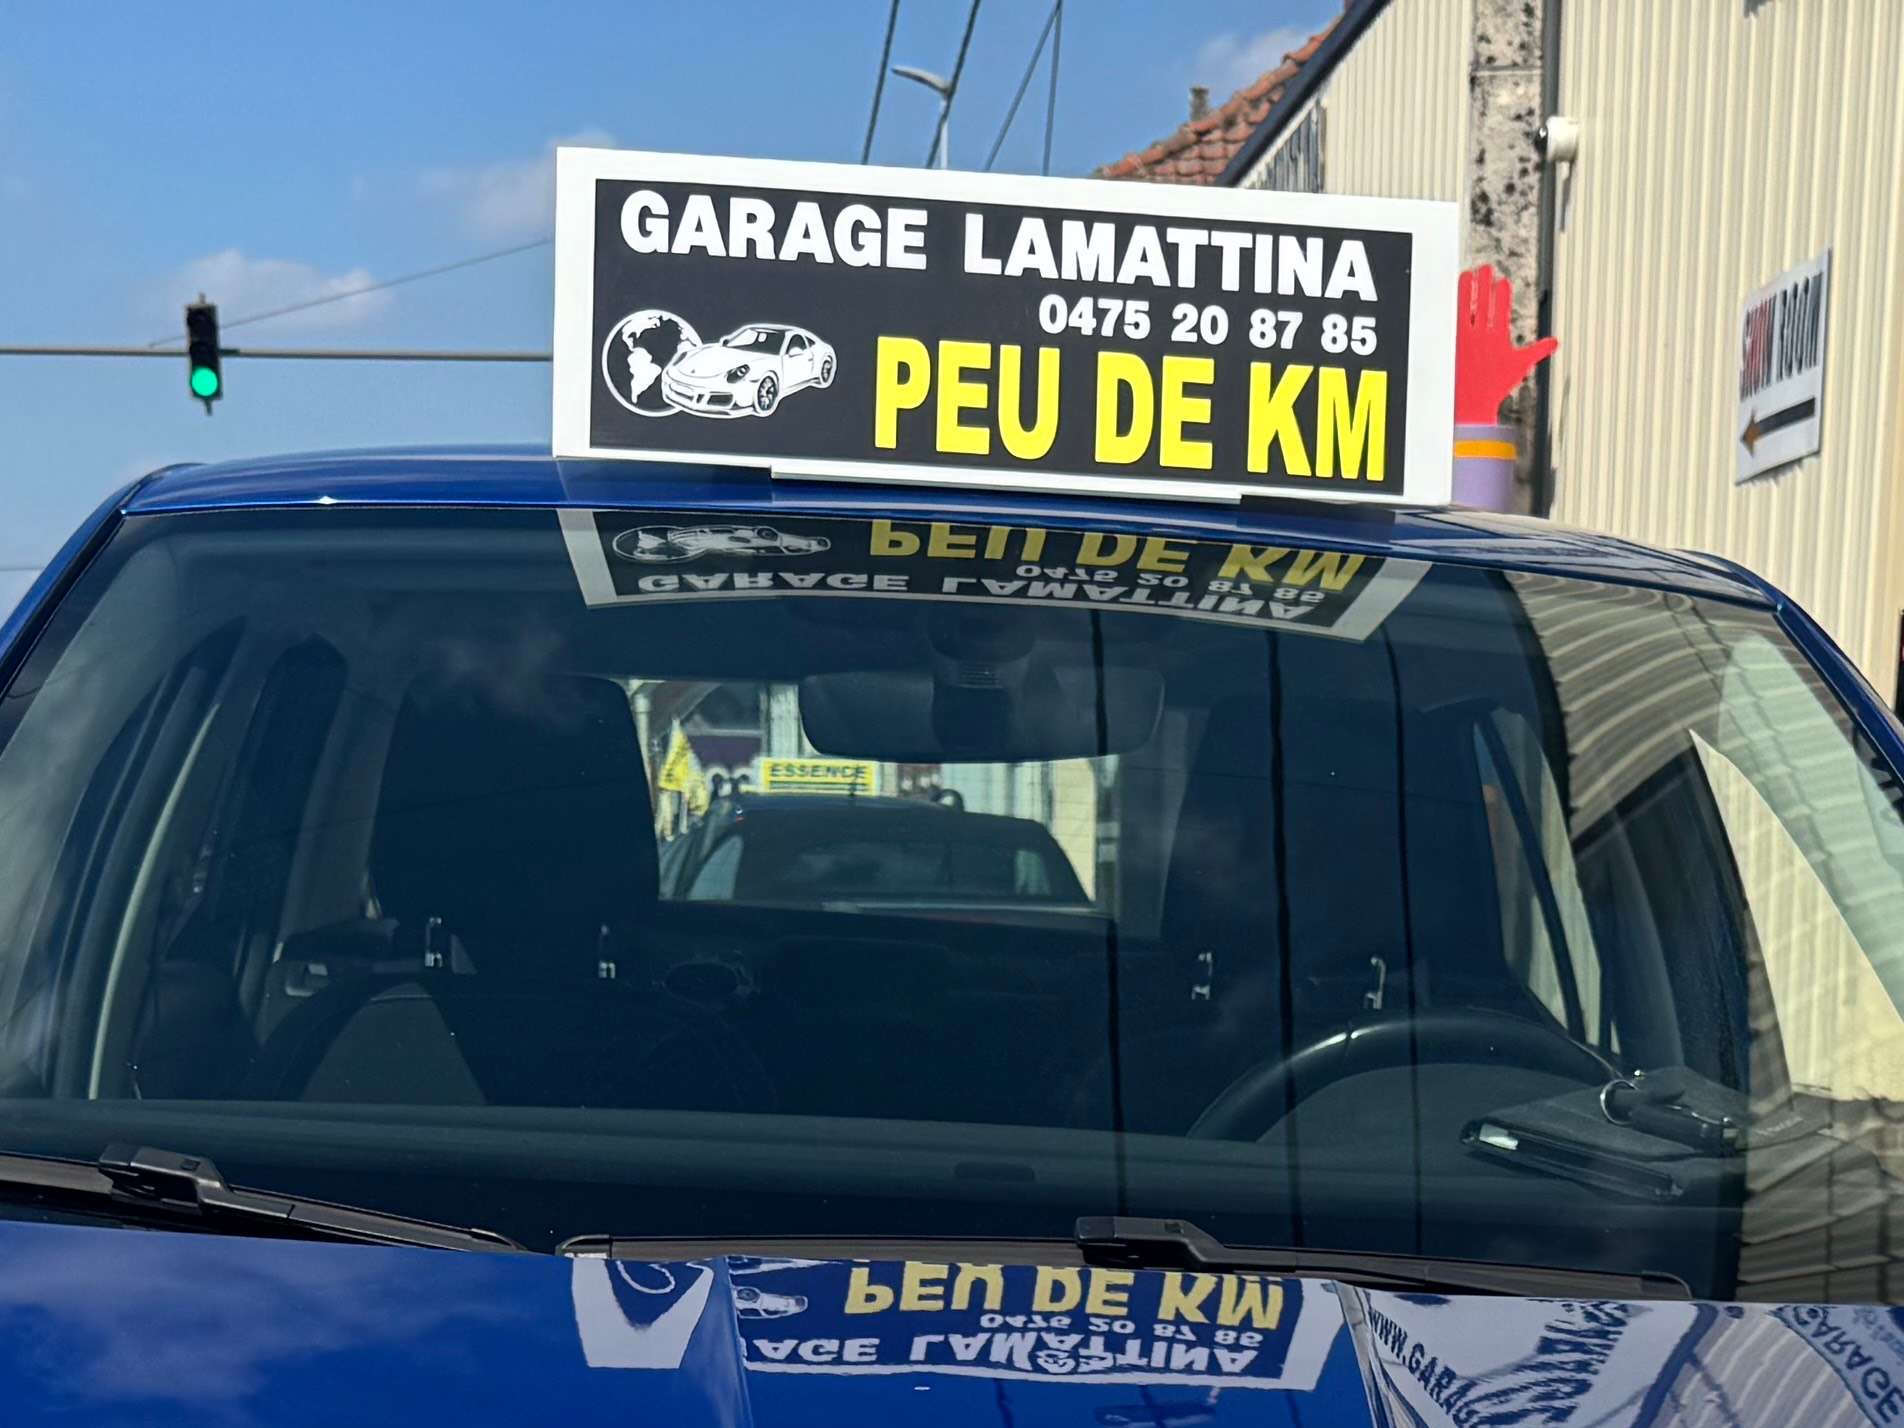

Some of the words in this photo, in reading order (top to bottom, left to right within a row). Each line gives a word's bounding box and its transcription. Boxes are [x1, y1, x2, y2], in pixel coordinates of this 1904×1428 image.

[621, 190, 927, 269] GARAGE
[964, 213, 1378, 302] LAMATTINA
[1039, 294, 1151, 340] 0475
[1171, 301, 1229, 346] 20
[1249, 309, 1303, 350] 87
[1320, 314, 1378, 357] 85
[875, 336, 1060, 460] PEU
[1094, 350, 1215, 471] DE
[1247, 363, 1388, 483] KM
[770, 763, 866, 779] ESSENCE
